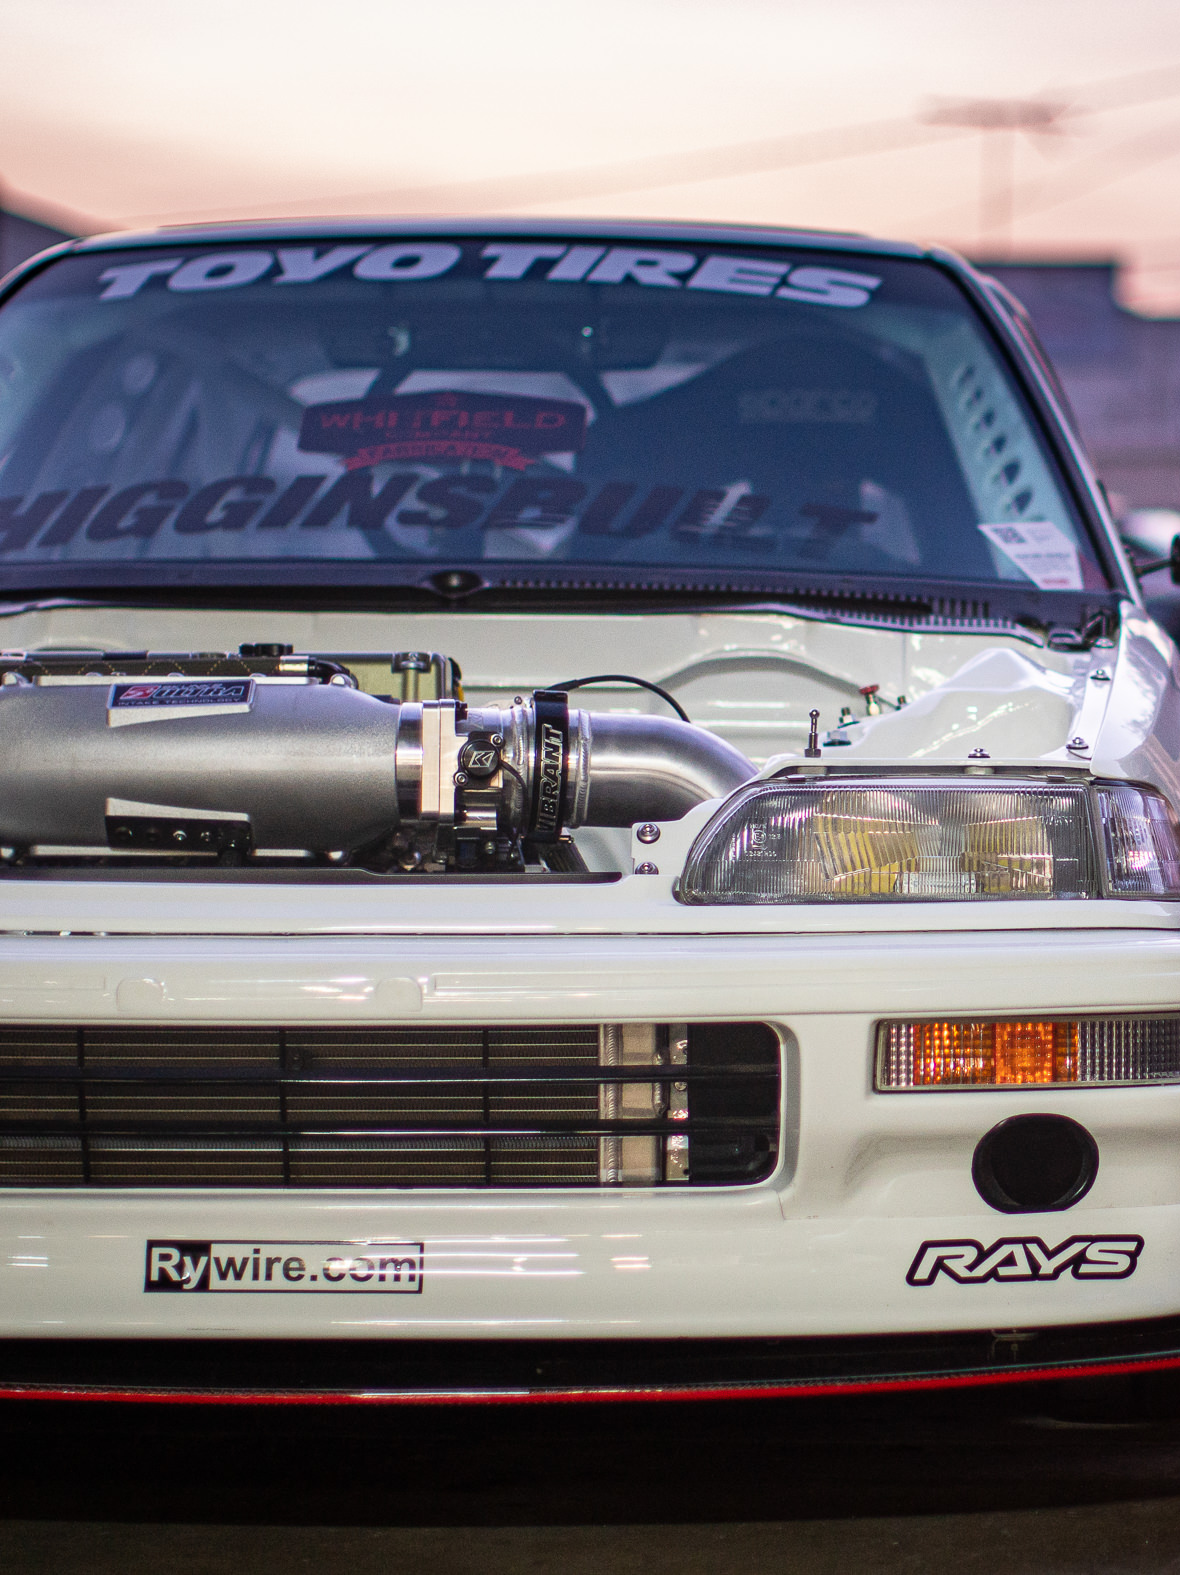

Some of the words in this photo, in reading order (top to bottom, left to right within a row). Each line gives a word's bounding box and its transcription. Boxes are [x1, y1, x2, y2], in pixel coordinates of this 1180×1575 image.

[99, 243, 460, 301] TOYO
[480, 243, 882, 308] TIRES
[320, 410, 566, 430] WHITFIELD
[537, 723, 564, 832] VIBRANT
[148, 1246, 418, 1290] Rywire.com
[906, 1234, 1144, 1287] RAYS
